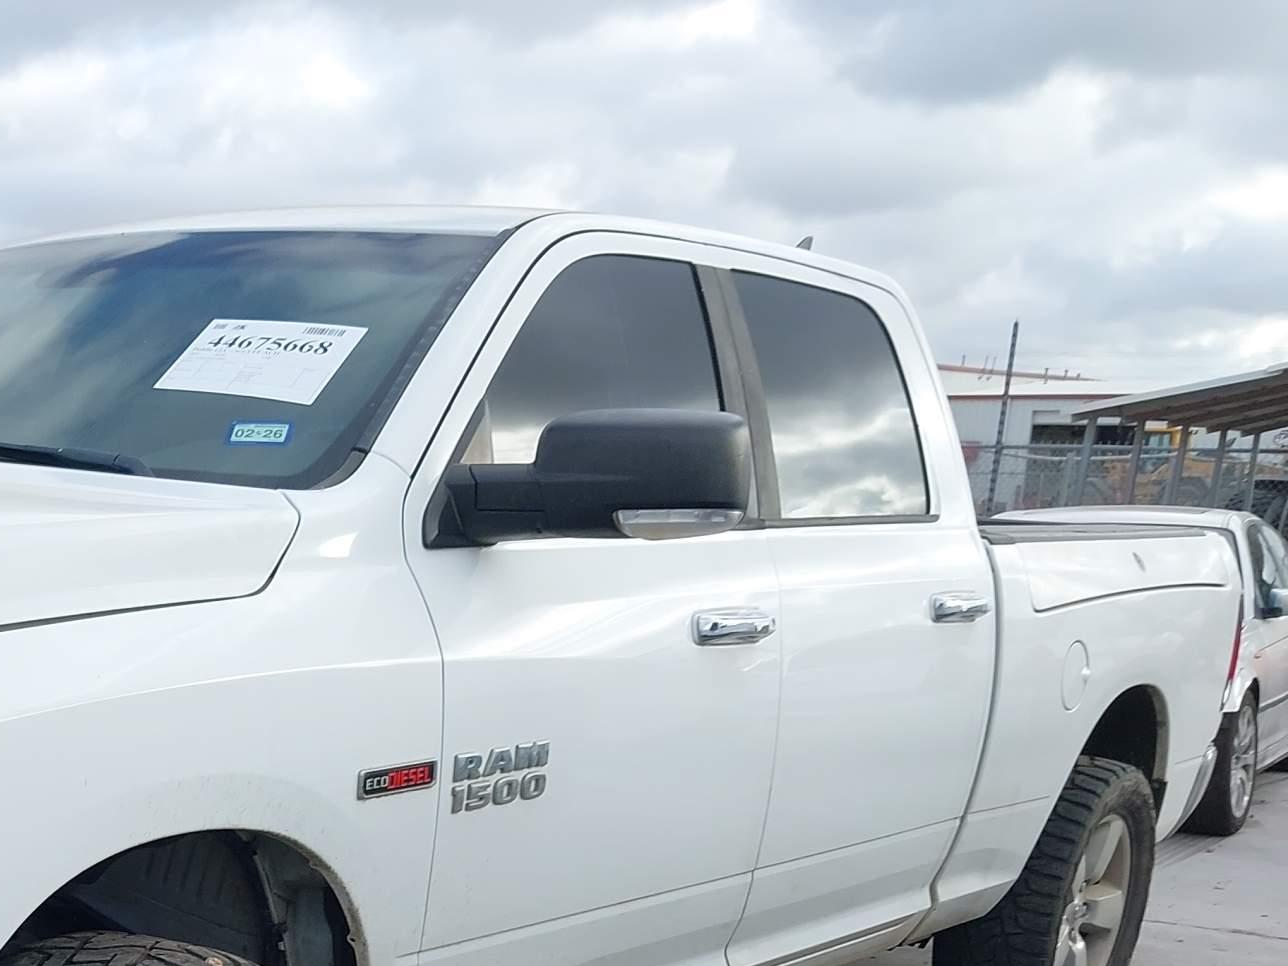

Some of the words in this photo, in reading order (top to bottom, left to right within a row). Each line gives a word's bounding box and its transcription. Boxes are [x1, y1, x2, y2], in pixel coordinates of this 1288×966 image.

[207, 335, 334, 356] 44675668
[452, 739, 551, 783] RAM
[450, 770, 547, 815] 1500
